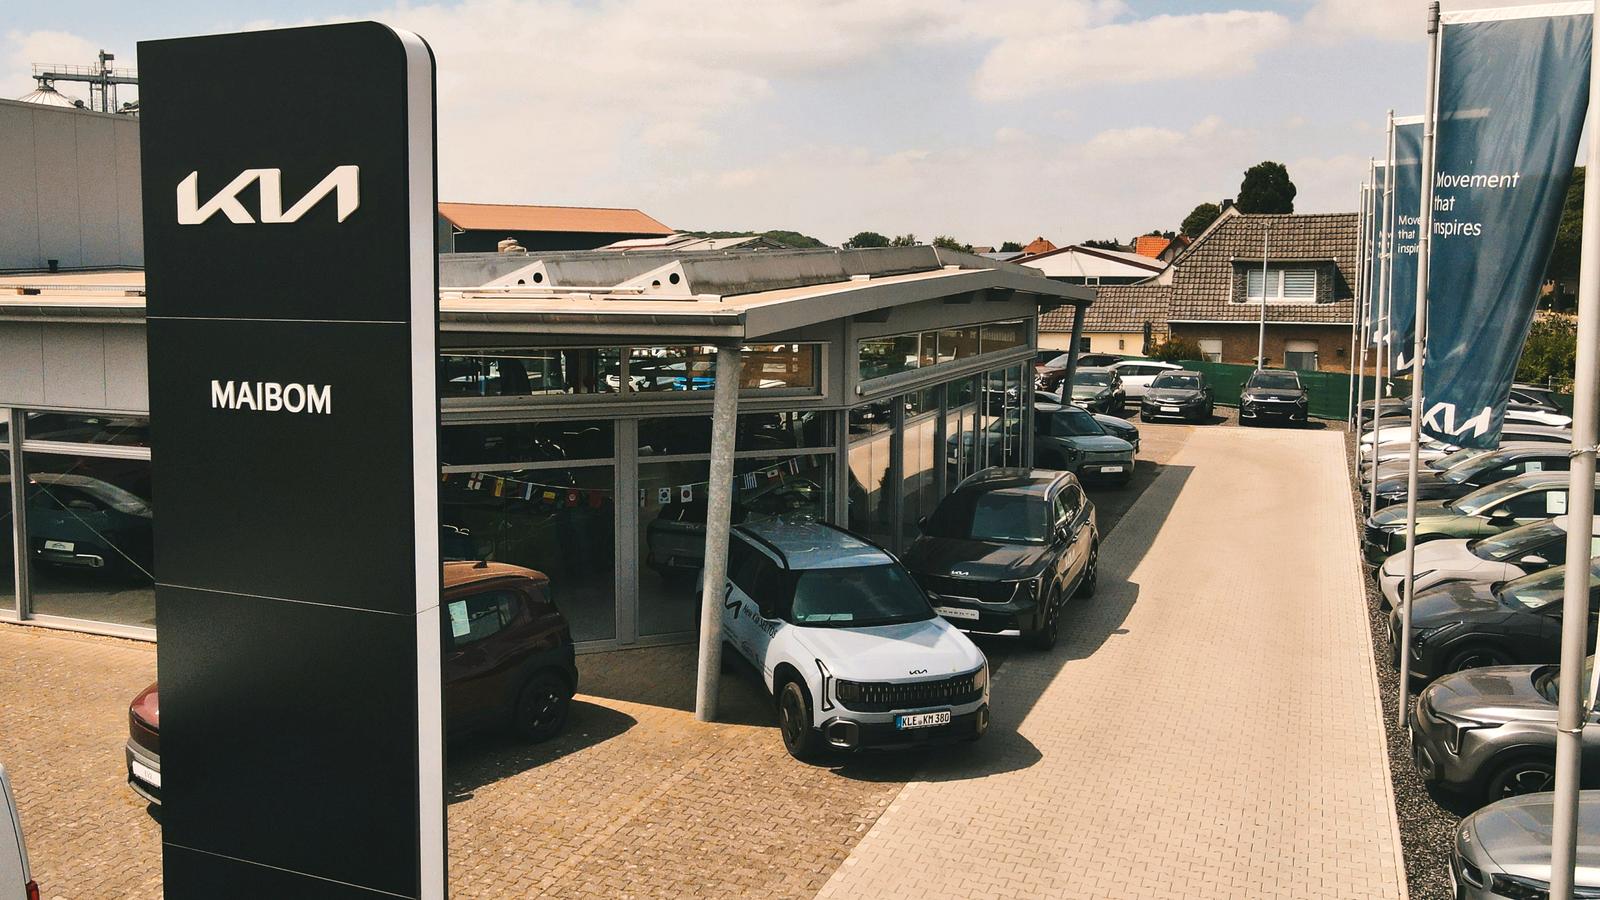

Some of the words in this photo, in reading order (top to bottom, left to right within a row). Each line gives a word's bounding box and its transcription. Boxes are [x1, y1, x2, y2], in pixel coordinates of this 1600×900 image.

[1436, 171, 1520, 188] Movement
[176, 164, 361, 225] KIA
[1434, 194, 1456, 211] that
[1398, 215, 1421, 225] Move
[1433, 218, 1482, 239] inspires
[1397, 229, 1416, 239] that
[1397, 243, 1420, 256] inspir
[211, 379, 332, 414] MAIBOM
[1420, 397, 1492, 439] KIA
[902, 716, 918, 726] KLE
[923, 714, 934, 724] KM
[934, 712, 950, 723] 380
